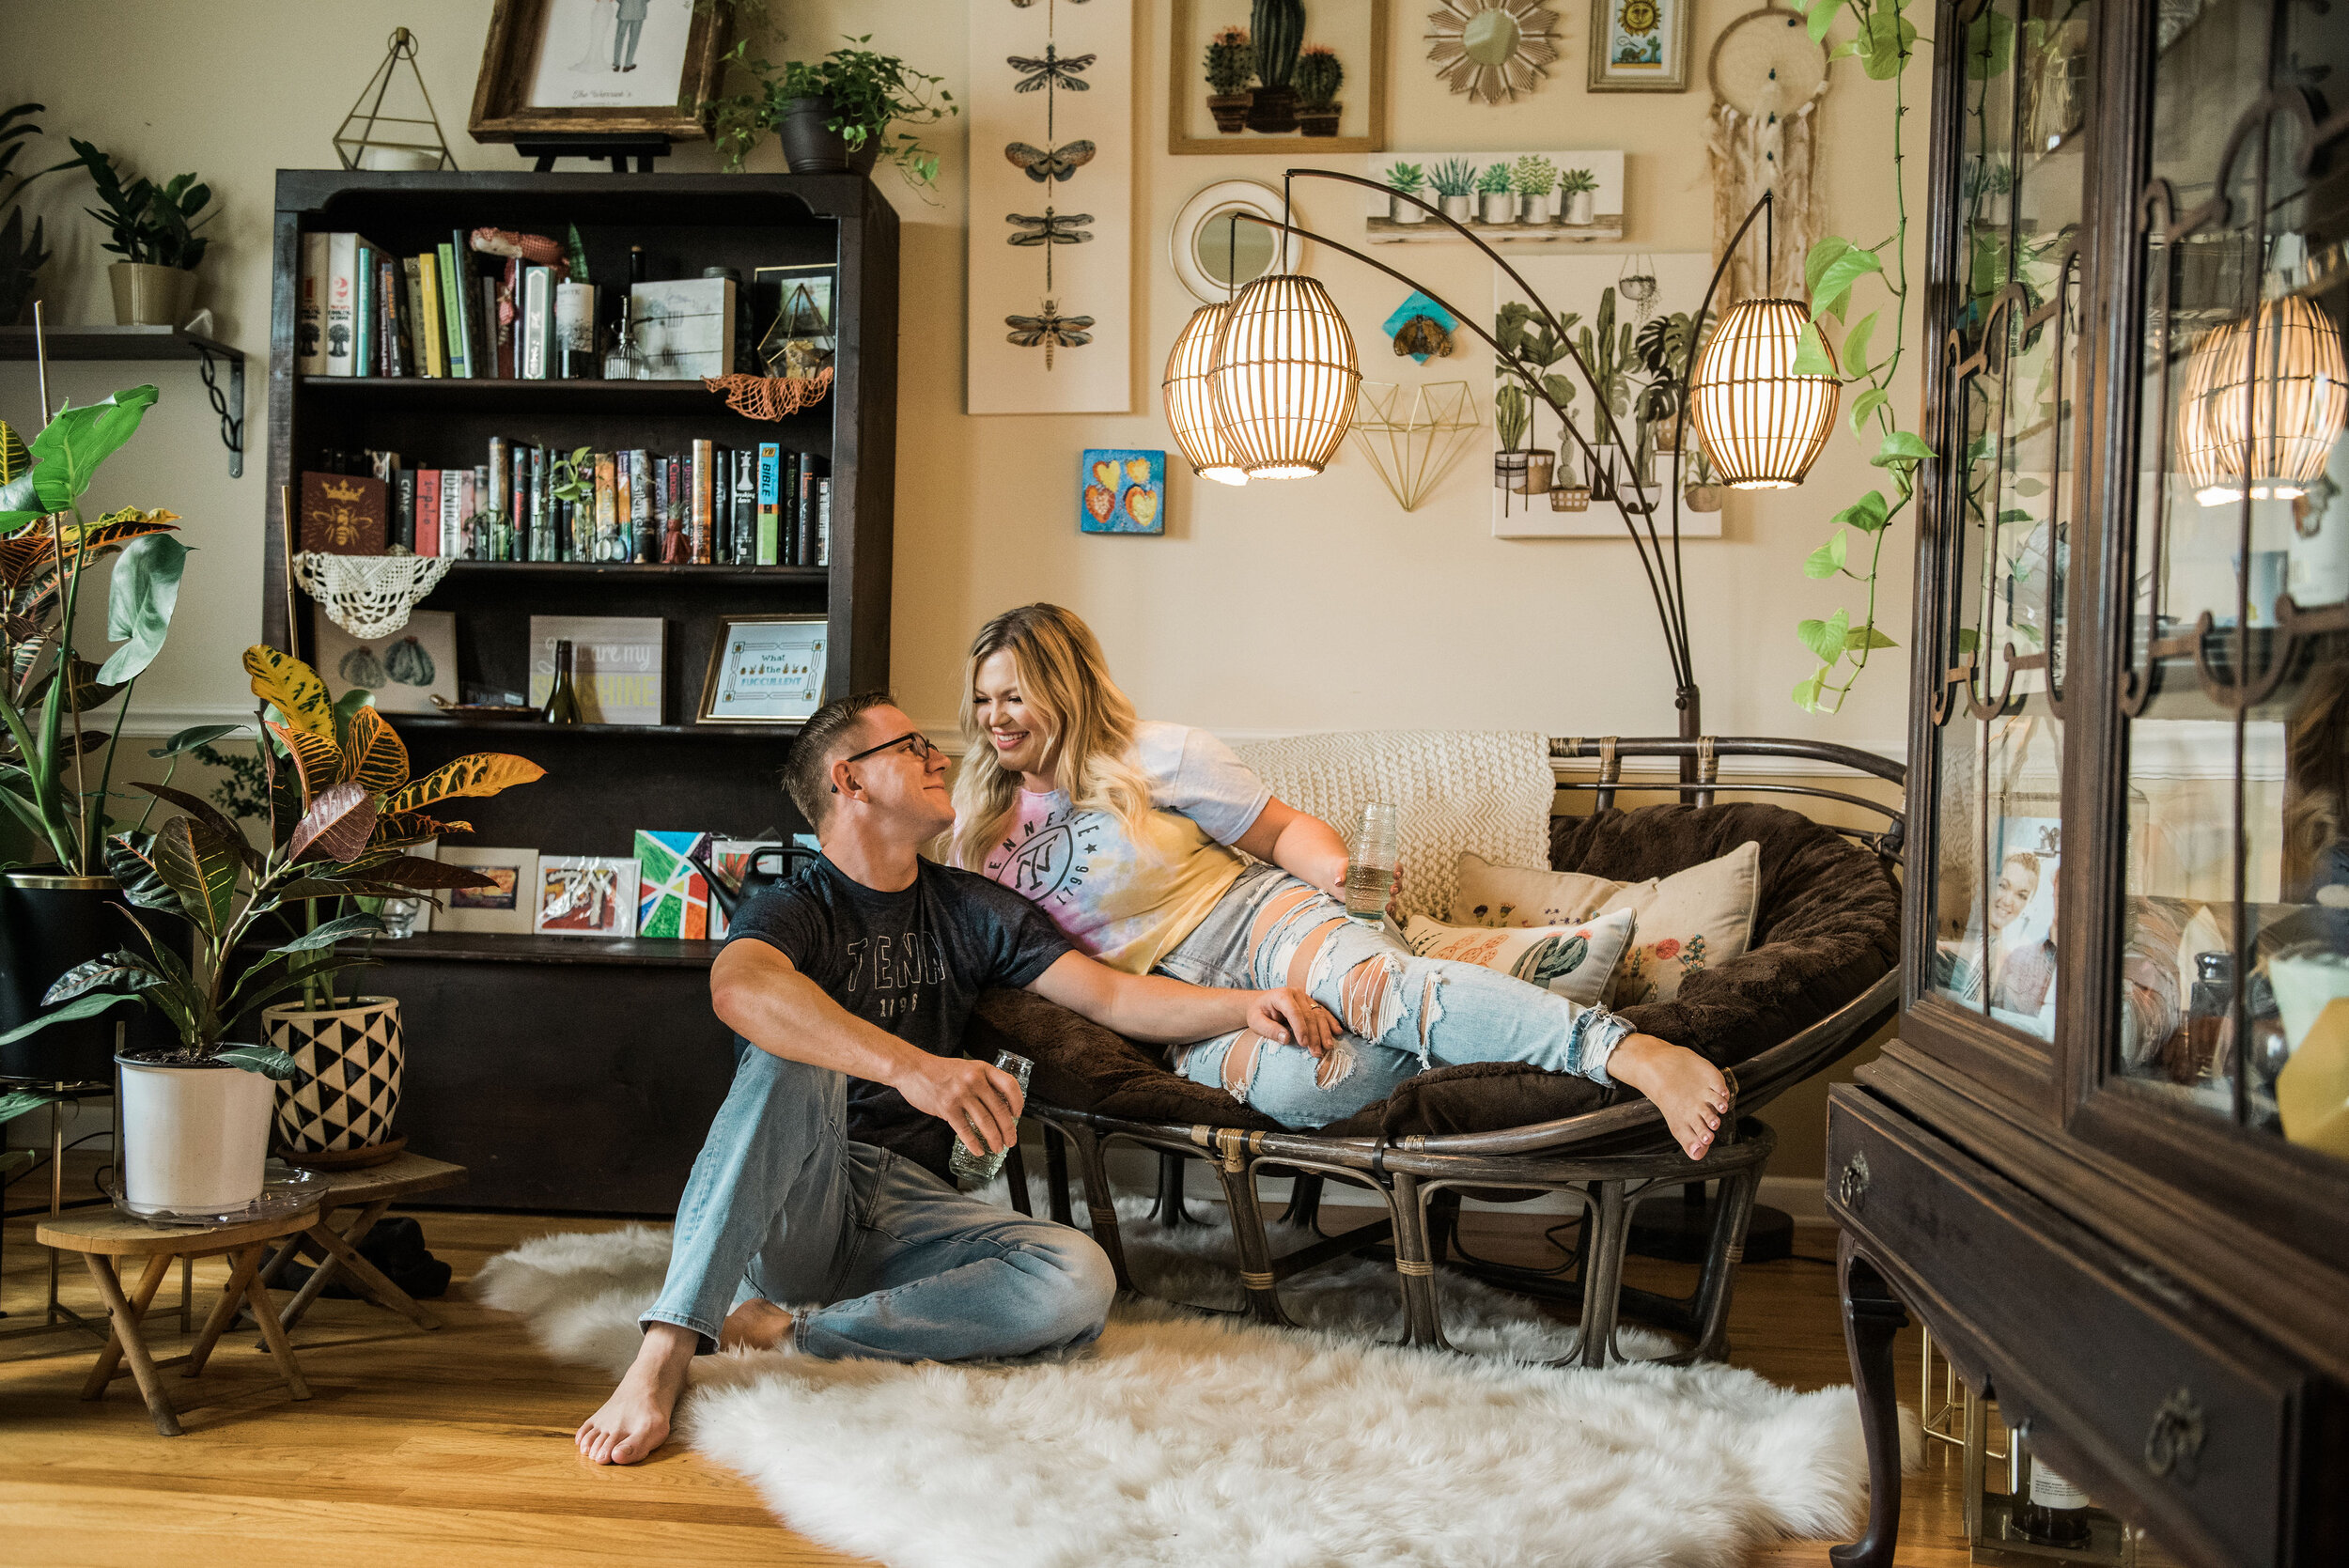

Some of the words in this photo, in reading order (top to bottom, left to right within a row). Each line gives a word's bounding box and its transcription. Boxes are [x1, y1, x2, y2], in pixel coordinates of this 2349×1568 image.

[761, 463, 770, 497] BIBLE
[443, 473, 459, 539] IDENTICAL
[632, 485, 646, 528] silence
[592, 644, 623, 662] are
[624, 644, 651, 671] my
[761, 654, 786, 662] What
[766, 665, 781, 674] the
[533, 675, 657, 707] SSHINE
[988, 808, 1099, 870] ENNESEE
[542, 868, 615, 928] JOY
[1056, 865, 1089, 905] 1796
